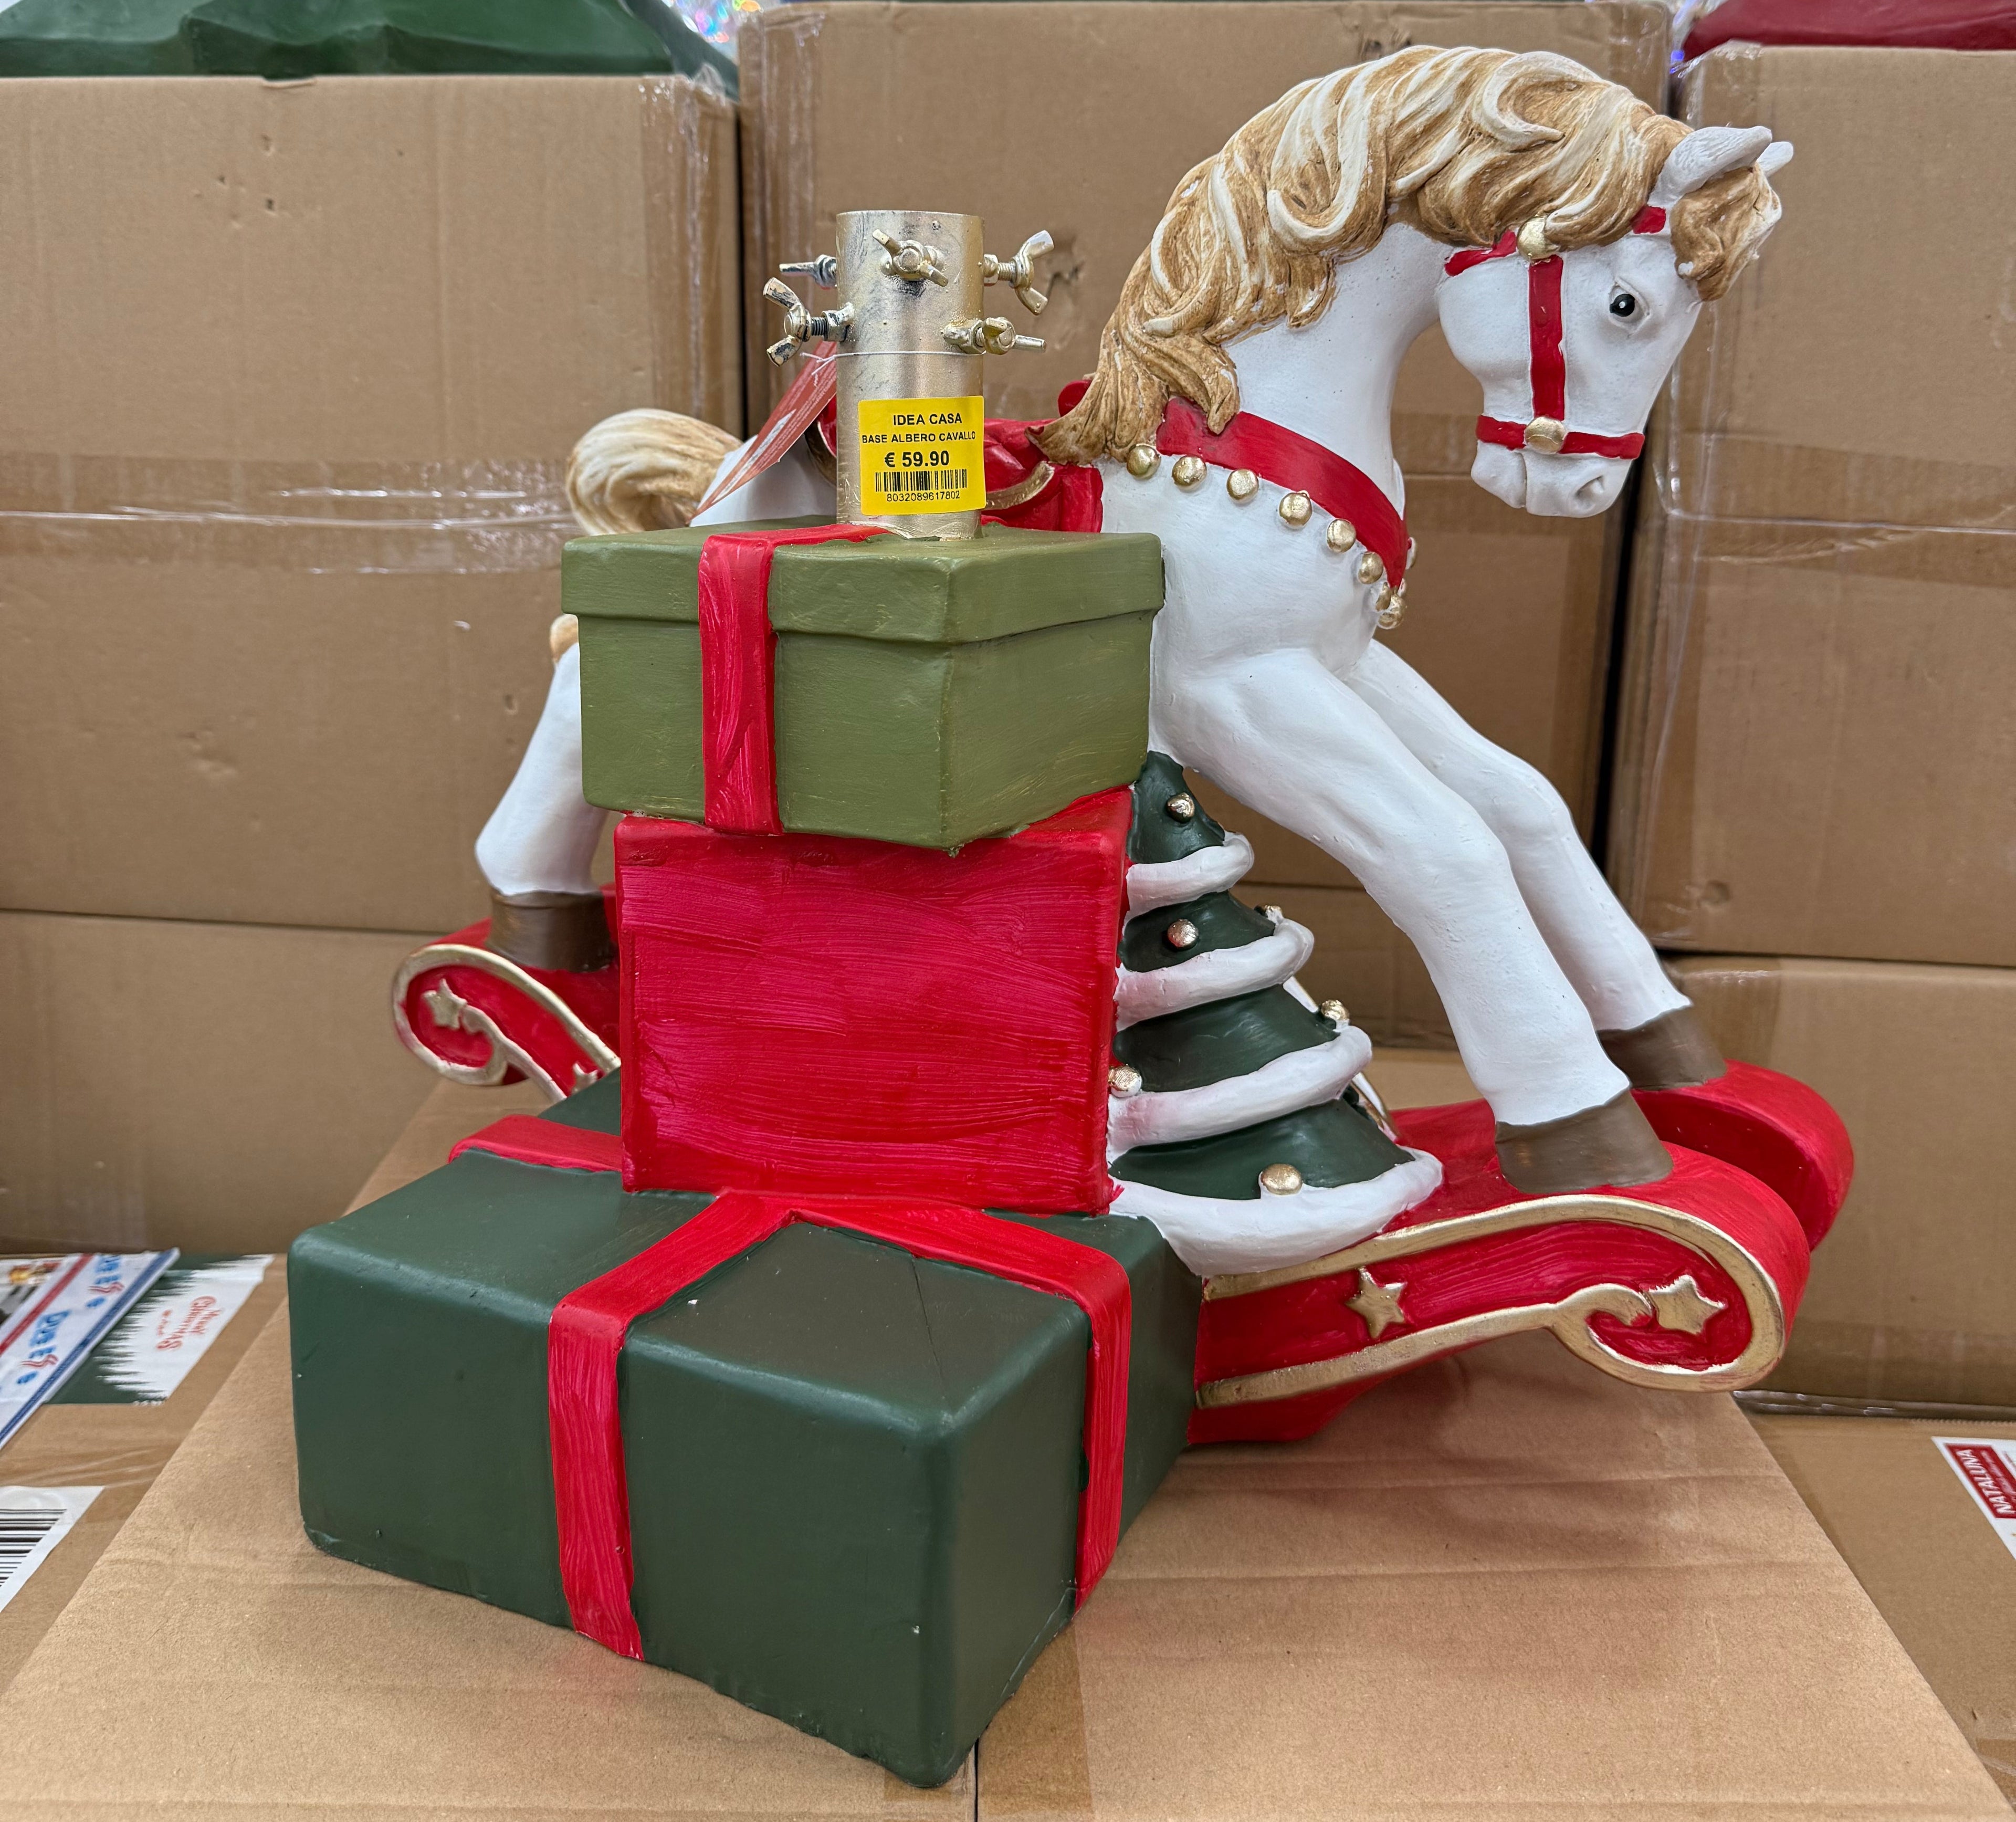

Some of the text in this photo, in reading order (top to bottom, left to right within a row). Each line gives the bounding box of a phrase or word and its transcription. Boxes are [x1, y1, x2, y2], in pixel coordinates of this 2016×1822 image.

[893, 413, 962, 426] IDEA CASA
[862, 431, 976, 443] BASE ALBERO CAVALLO
[884, 451, 949, 467] € 59.90
[887, 490, 960, 502] 8032089617802
[1956, 1449, 2016, 1514] NATALUNA
